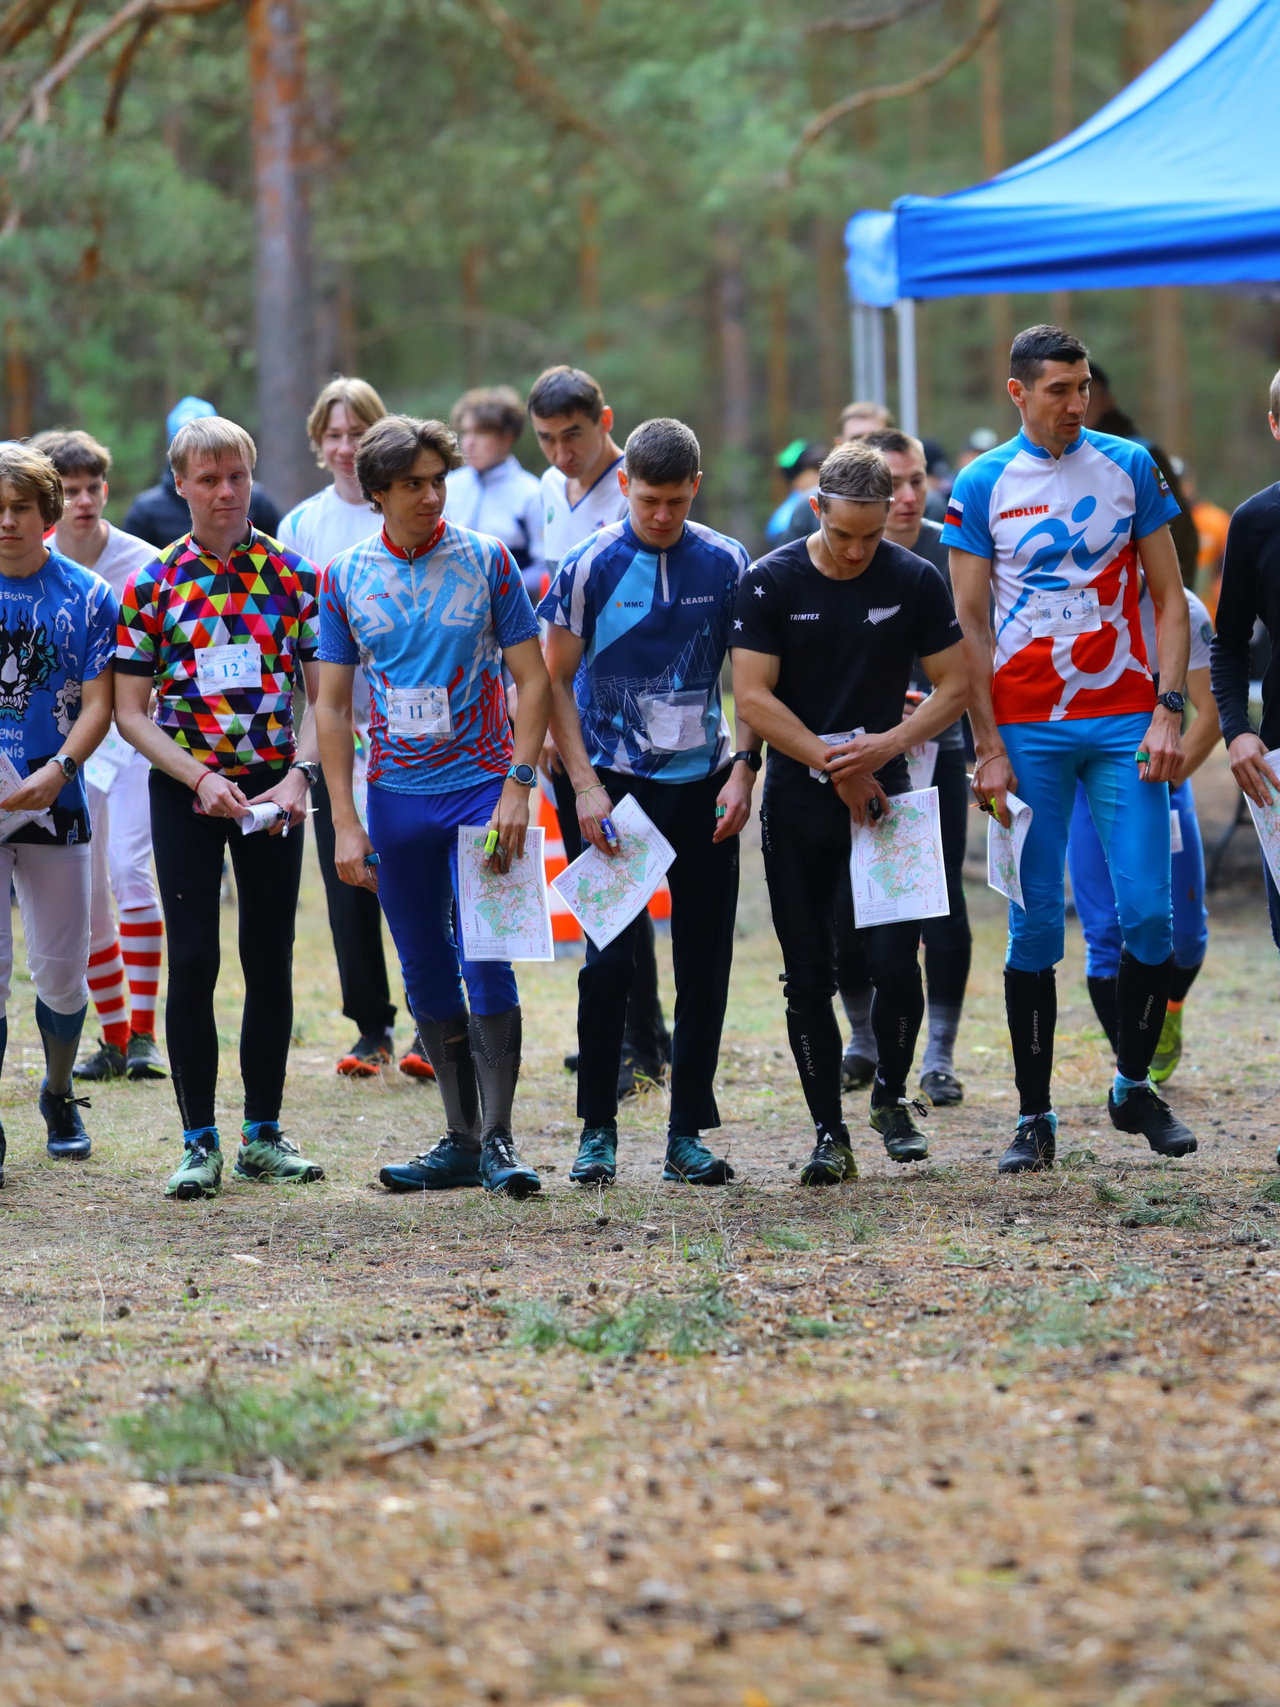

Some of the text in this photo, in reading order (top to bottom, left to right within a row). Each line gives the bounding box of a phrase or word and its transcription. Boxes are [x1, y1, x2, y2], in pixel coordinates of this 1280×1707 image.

[1000, 504, 1049, 520] REDLINE
[681, 596, 714, 605] LEADER
[1062, 606, 1072, 620] 6
[223, 663, 240, 678] 12
[409, 705, 423, 718] 11
